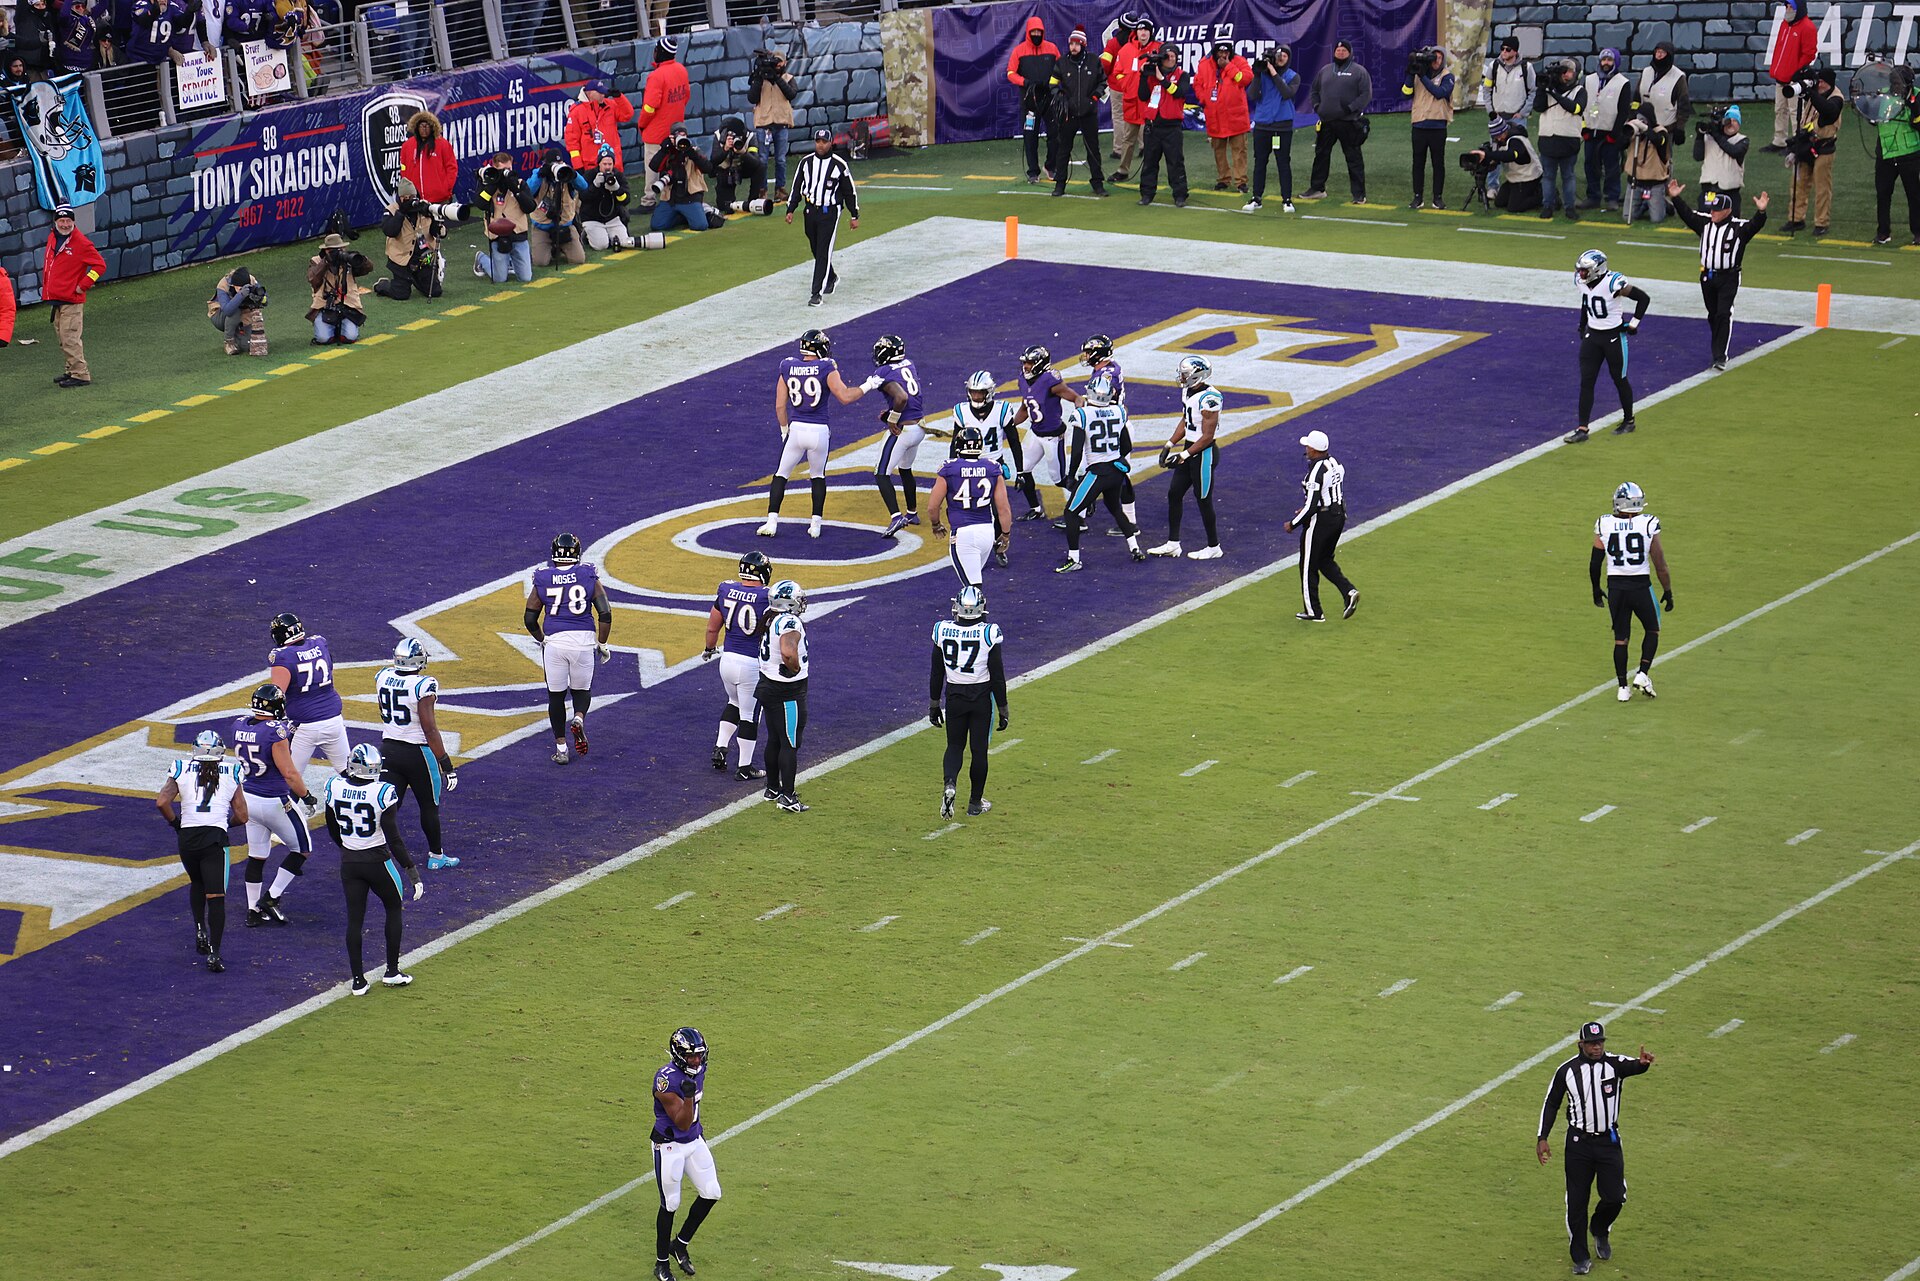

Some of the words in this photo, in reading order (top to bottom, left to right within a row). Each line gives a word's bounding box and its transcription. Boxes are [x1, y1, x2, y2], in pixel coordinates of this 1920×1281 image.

[150, 20, 172, 44] 19
[1153, 24, 1207, 42] ALUTE
[508, 78, 524, 104] 45
[389, 105, 401, 125] 98
[262, 125, 278, 151] 98
[384, 123, 409, 145] GOOSE
[190, 161, 243, 212] TONY
[250, 140, 351, 201] SIRAGUSA
[237, 203, 264, 228] 1967
[276, 196, 305, 221] 2022
[789, 365, 820, 377] ANDREWS
[901, 367, 919, 396] 8
[787, 376, 822, 408] 89
[1089, 419, 1121, 453] 25
[961, 467, 987, 478] RICARD
[1331, 472, 1342, 486] 23
[953, 477, 992, 509] 42
[91, 486, 311, 539] US
[1607, 532, 1646, 566] 49
[552, 573, 577, 585] MOSES
[546, 584, 588, 616] 78
[727, 588, 758, 604] ZEITLER
[723, 598, 757, 636] 70
[296, 645, 323, 662] POWERS
[942, 638, 981, 674] 97
[297, 658, 332, 692] 72
[379, 687, 412, 726] 95
[234, 743, 268, 777] 65
[341, 787, 367, 801] BURNS
[334, 799, 377, 838] 53
